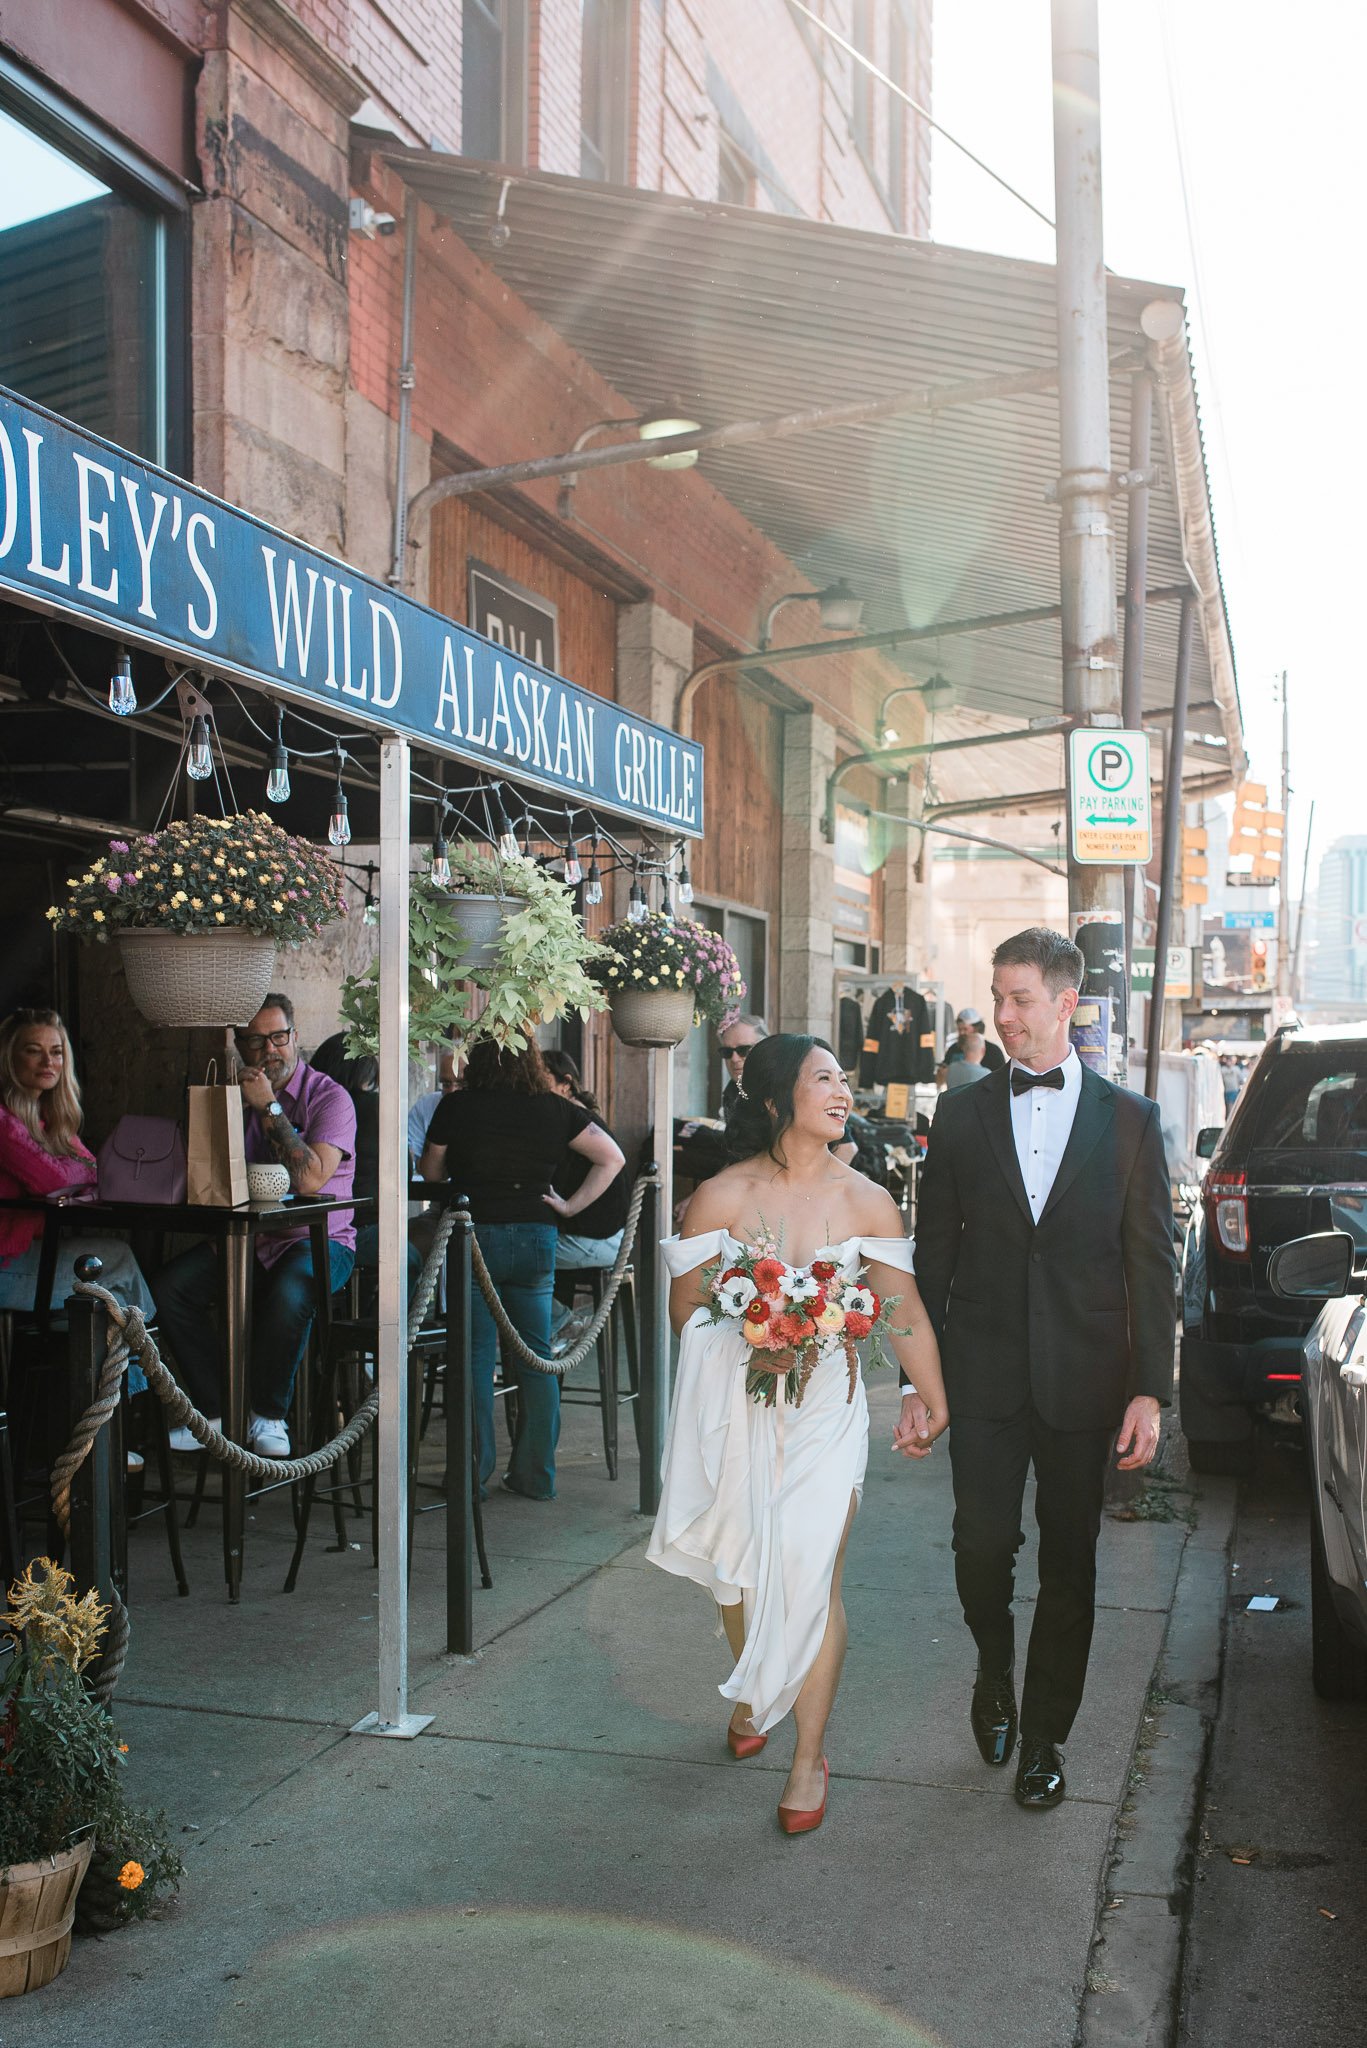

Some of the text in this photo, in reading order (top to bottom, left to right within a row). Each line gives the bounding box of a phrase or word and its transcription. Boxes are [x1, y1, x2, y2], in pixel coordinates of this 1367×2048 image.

[261, 545, 403, 709] WILD
[434, 635, 595, 787] ALASKAN
[614, 722, 696, 824] GRILLE
[1101, 750, 1122, 780] P
[1080, 796, 1144, 811] PAY PARKING
[1079, 832, 1143, 841] ENTER LICENSE PLATE
